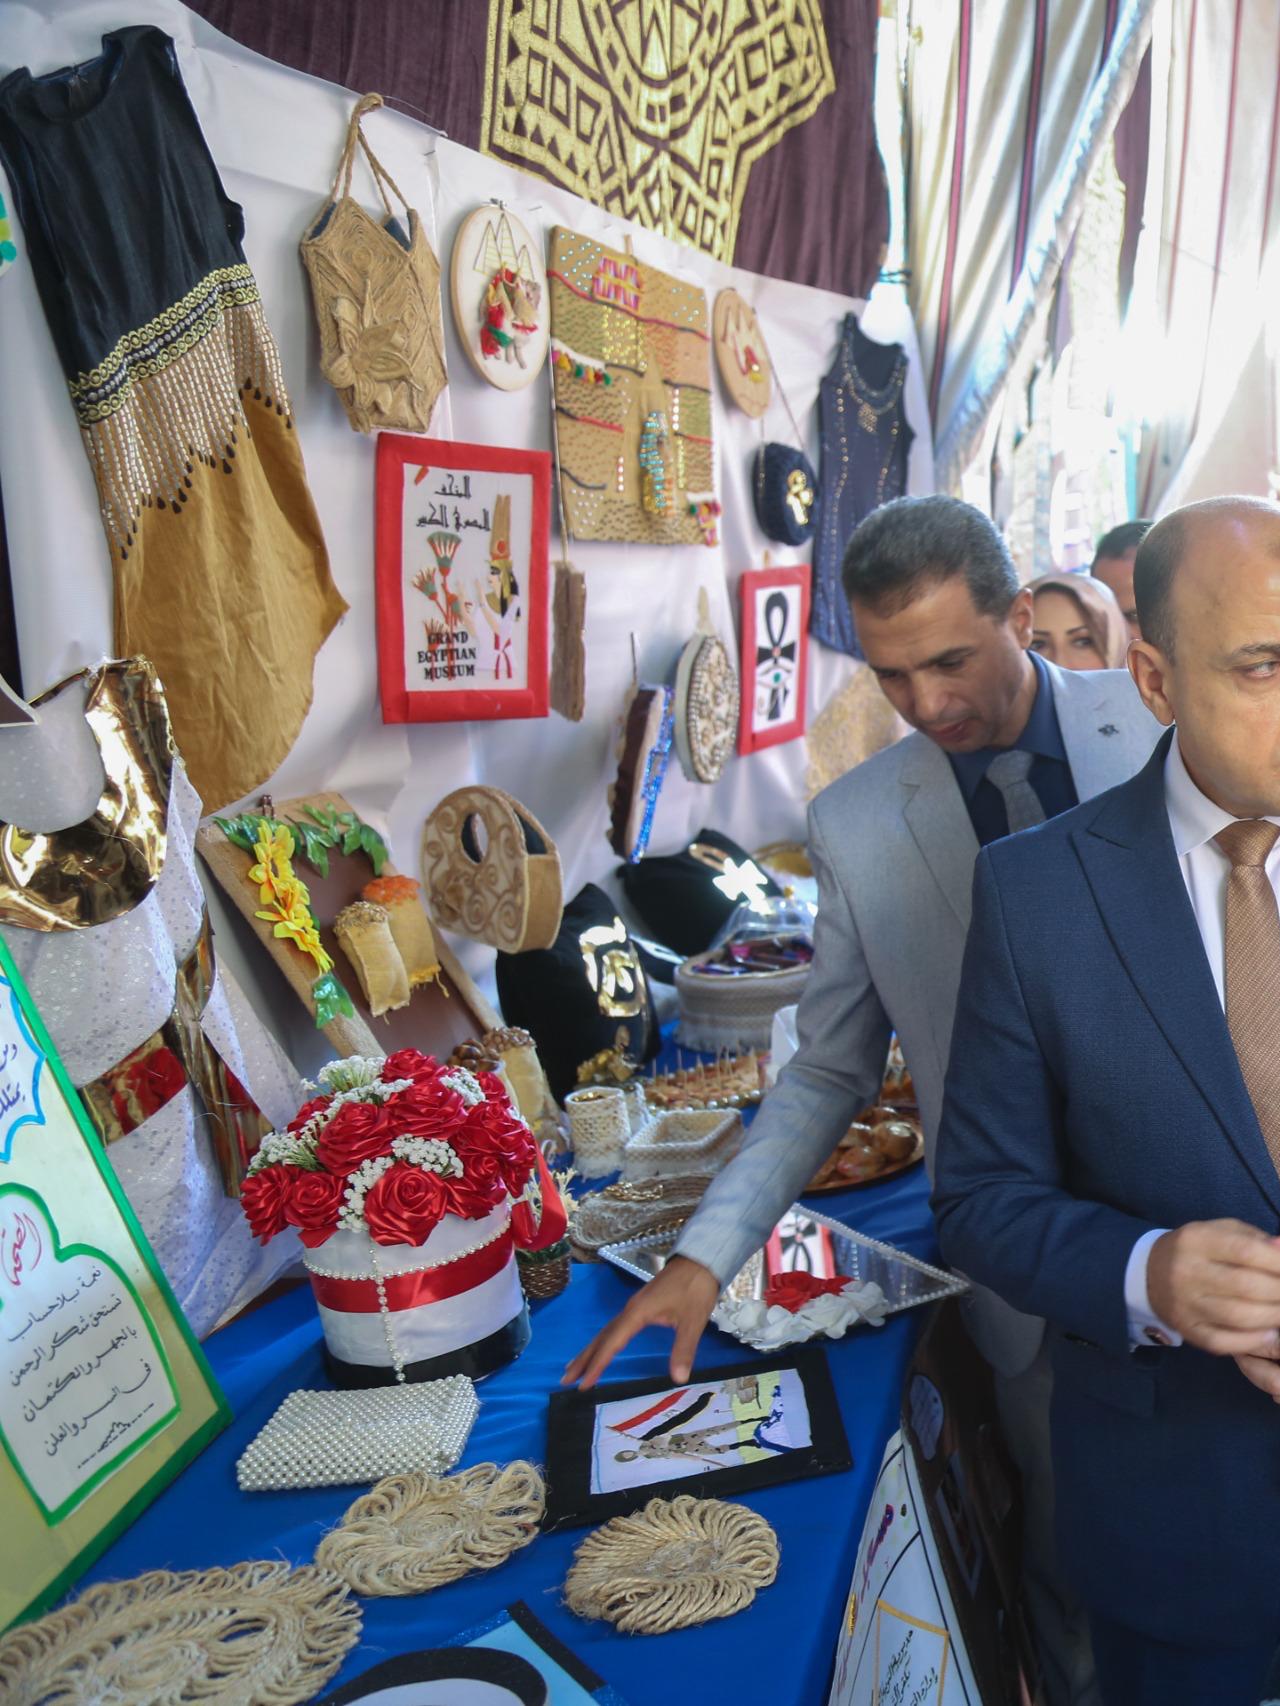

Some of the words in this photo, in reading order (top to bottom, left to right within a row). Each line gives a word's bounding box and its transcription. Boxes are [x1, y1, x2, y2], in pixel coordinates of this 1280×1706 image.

[417, 647, 477, 663] EGYPTIAN
[427, 631, 469, 645] GRAND
[424, 664, 476, 680] MUSEUM
[47, 1315, 91, 1361] شكر
[94, 1325, 138, 1369] بالجهر
[10, 1346, 47, 1387] الرحمن
[22, 1361, 94, 1422] والكتمان
[44, 1421, 81, 1457] والعلن
